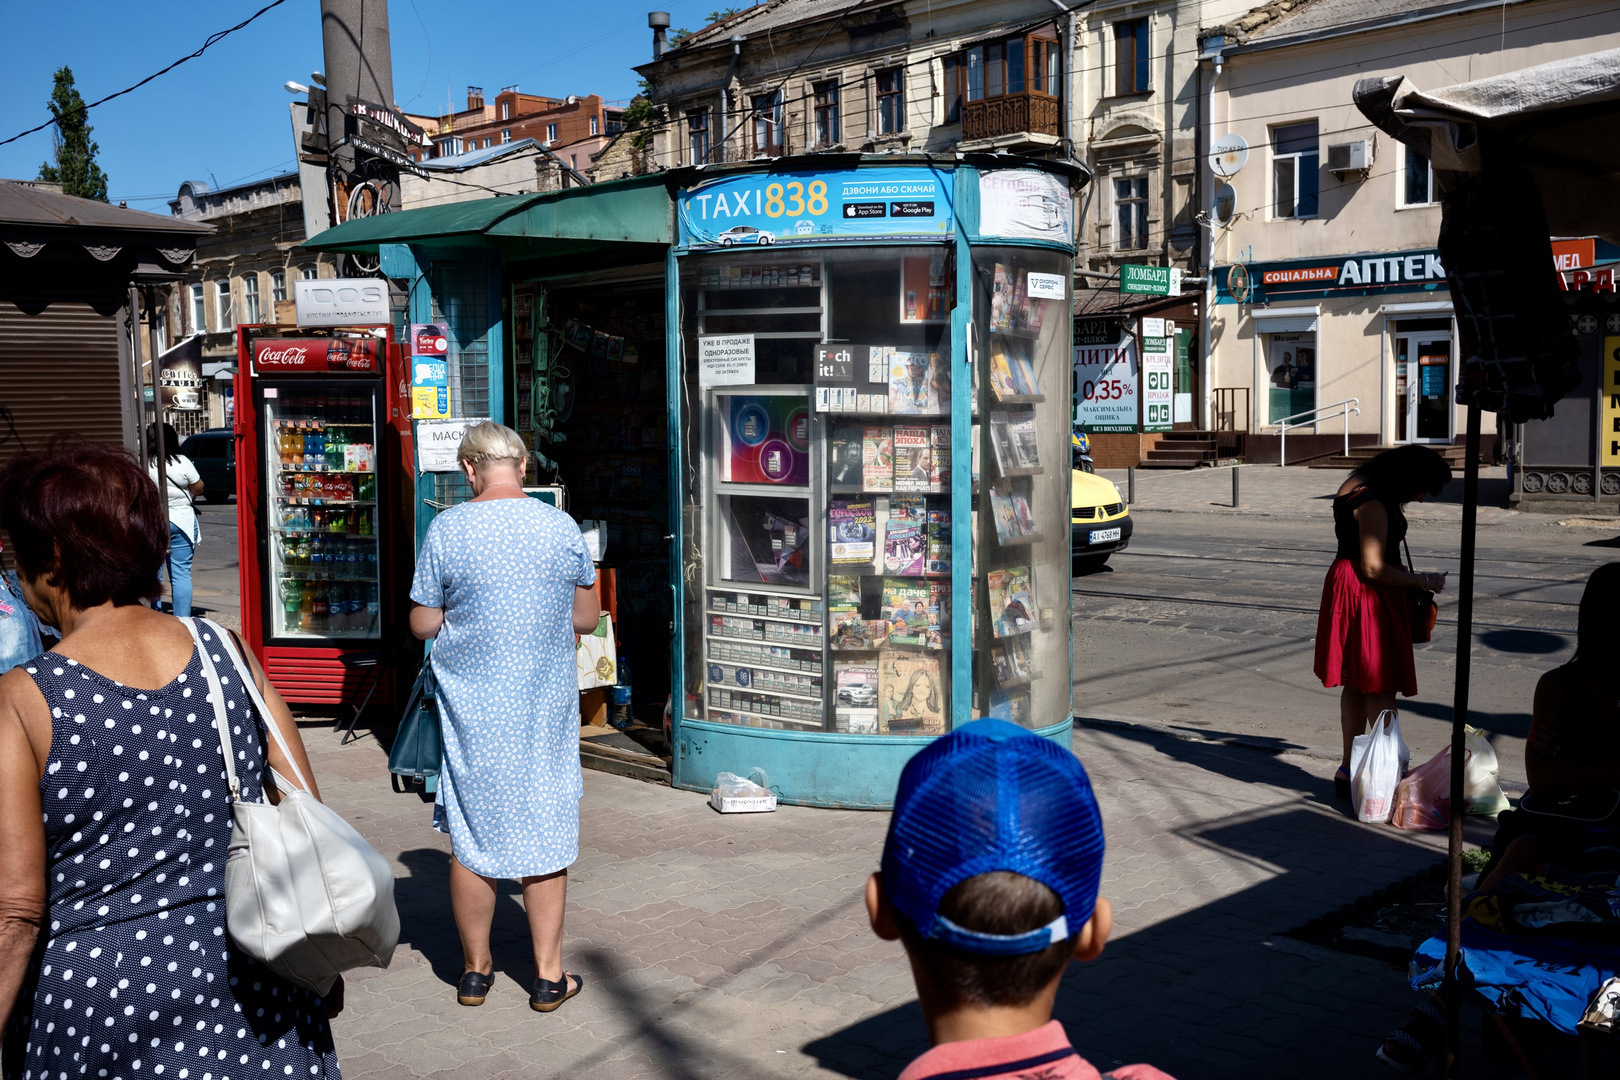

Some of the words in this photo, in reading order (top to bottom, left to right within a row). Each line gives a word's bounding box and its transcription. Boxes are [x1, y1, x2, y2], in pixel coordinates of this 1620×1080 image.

[842, 187, 879, 196] ДЗВОНИ
[880, 186, 898, 194] АБО
[901, 184, 935, 194] СКАЧАЙ
[697, 189, 761, 219] TAXI
[765, 180, 828, 218] 838
[1127, 267, 1168, 284] ЛОМБАРД
[1265, 270, 1333, 283] СОЦІАЛЬНА
[305, 287, 382, 307] IQOS
[258, 347, 309, 365] Coca-Cola
[704, 348, 750, 357] ОДНОРАЗОВЫЕ
[161, 368, 198, 379] Coffee
[819, 364, 834, 377] it!
[1083, 406, 1133, 414] МАКСИМАЛЬНА
[830, 508, 872, 517] ГОРОСКОП
[855, 515, 873, 523] 2022
[898, 588, 927, 598] даче
